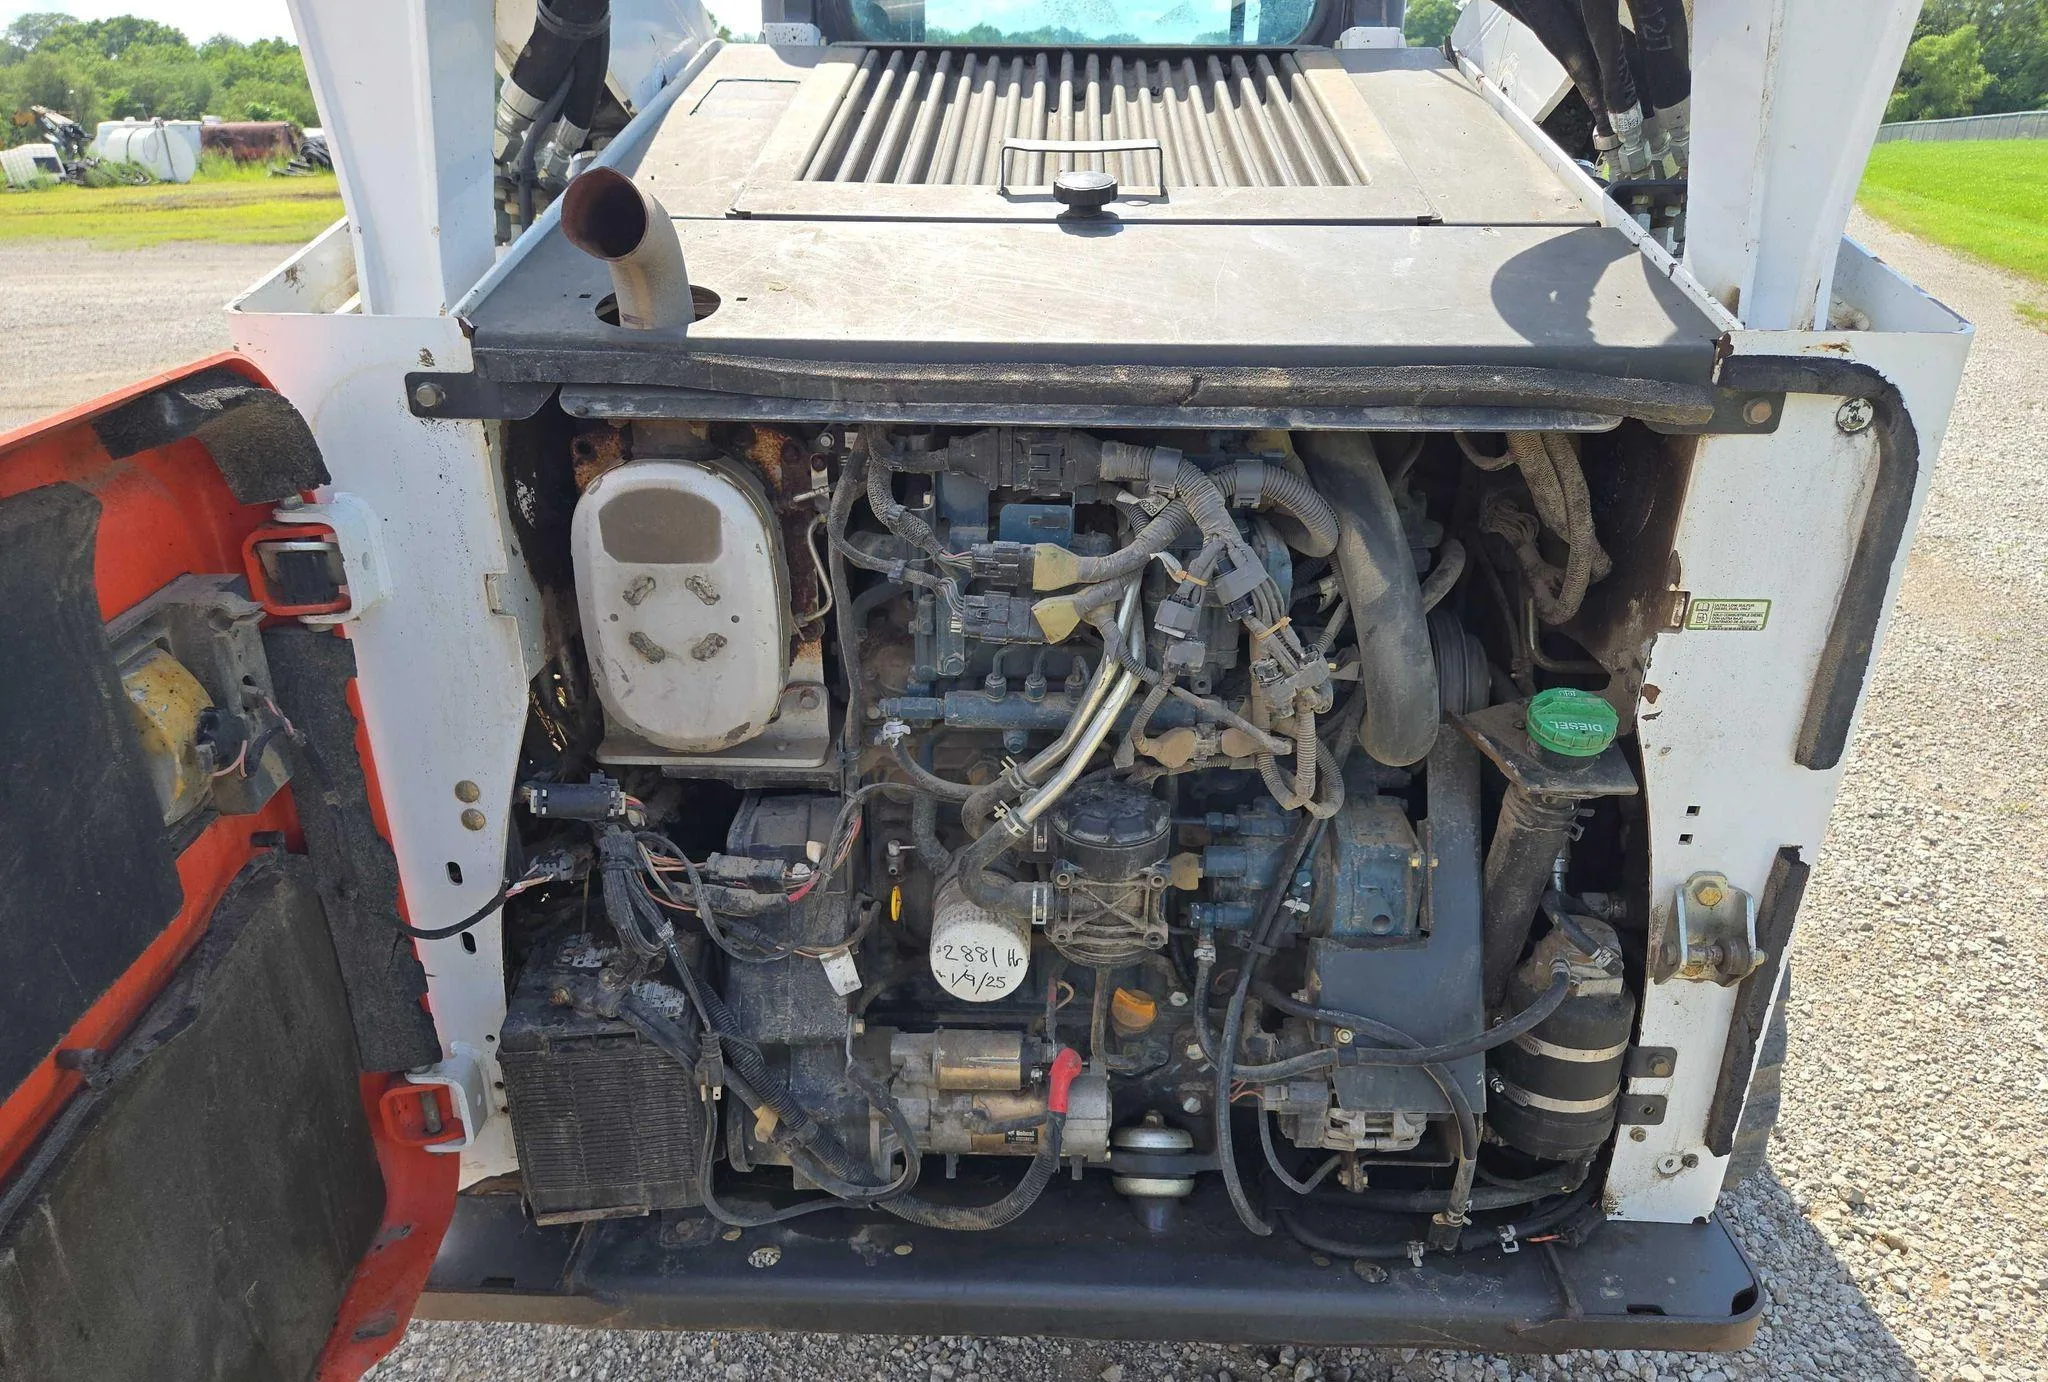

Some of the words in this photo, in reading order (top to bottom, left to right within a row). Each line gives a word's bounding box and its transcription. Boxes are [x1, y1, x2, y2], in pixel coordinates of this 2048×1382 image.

[1550, 720, 1603, 732] DIESEL
[943, 945, 998, 967] 2881
[1007, 948, 1023, 967] Hr
[951, 969, 1006, 995] 1/9/25
